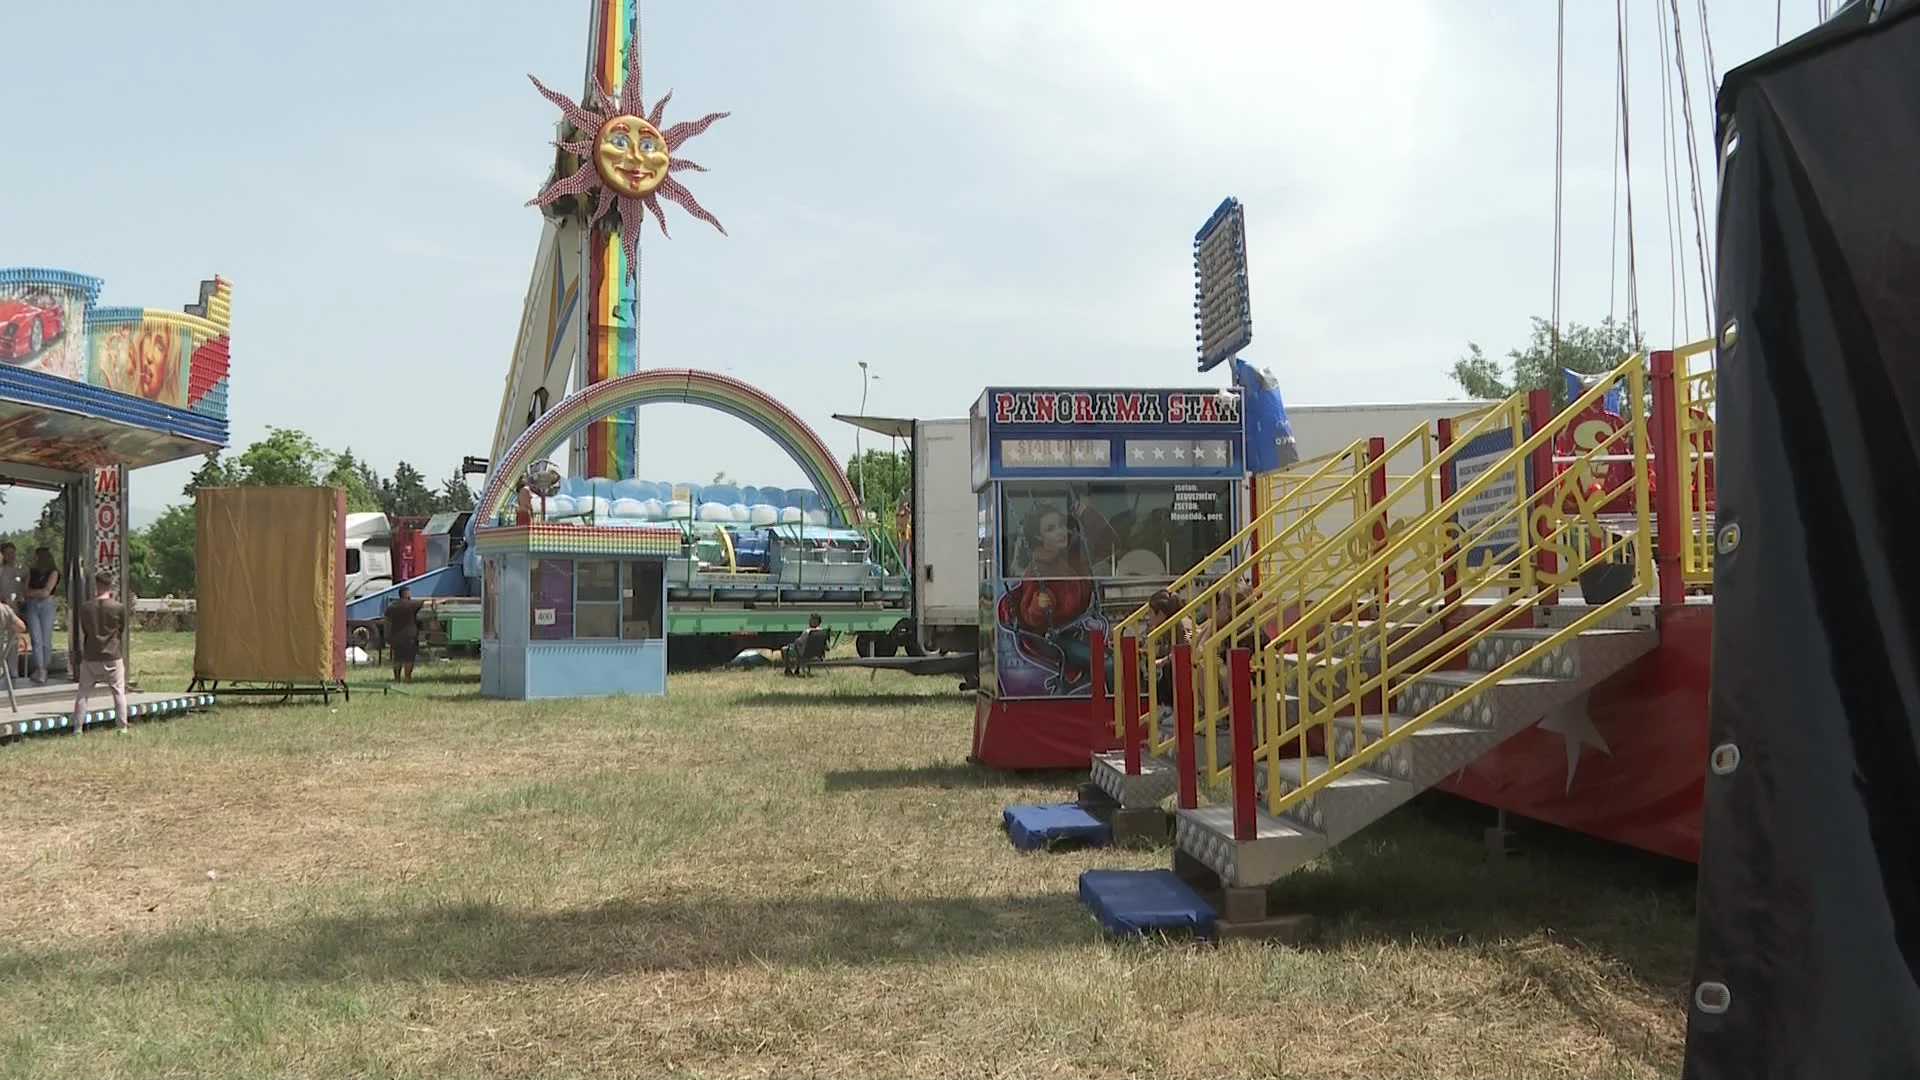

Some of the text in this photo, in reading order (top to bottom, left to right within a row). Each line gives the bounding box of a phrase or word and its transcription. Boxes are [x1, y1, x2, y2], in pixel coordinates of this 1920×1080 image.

[996, 393, 1163, 423] PANORAMA
[97, 468, 117, 566] MON
[537, 612, 553, 622] 400
